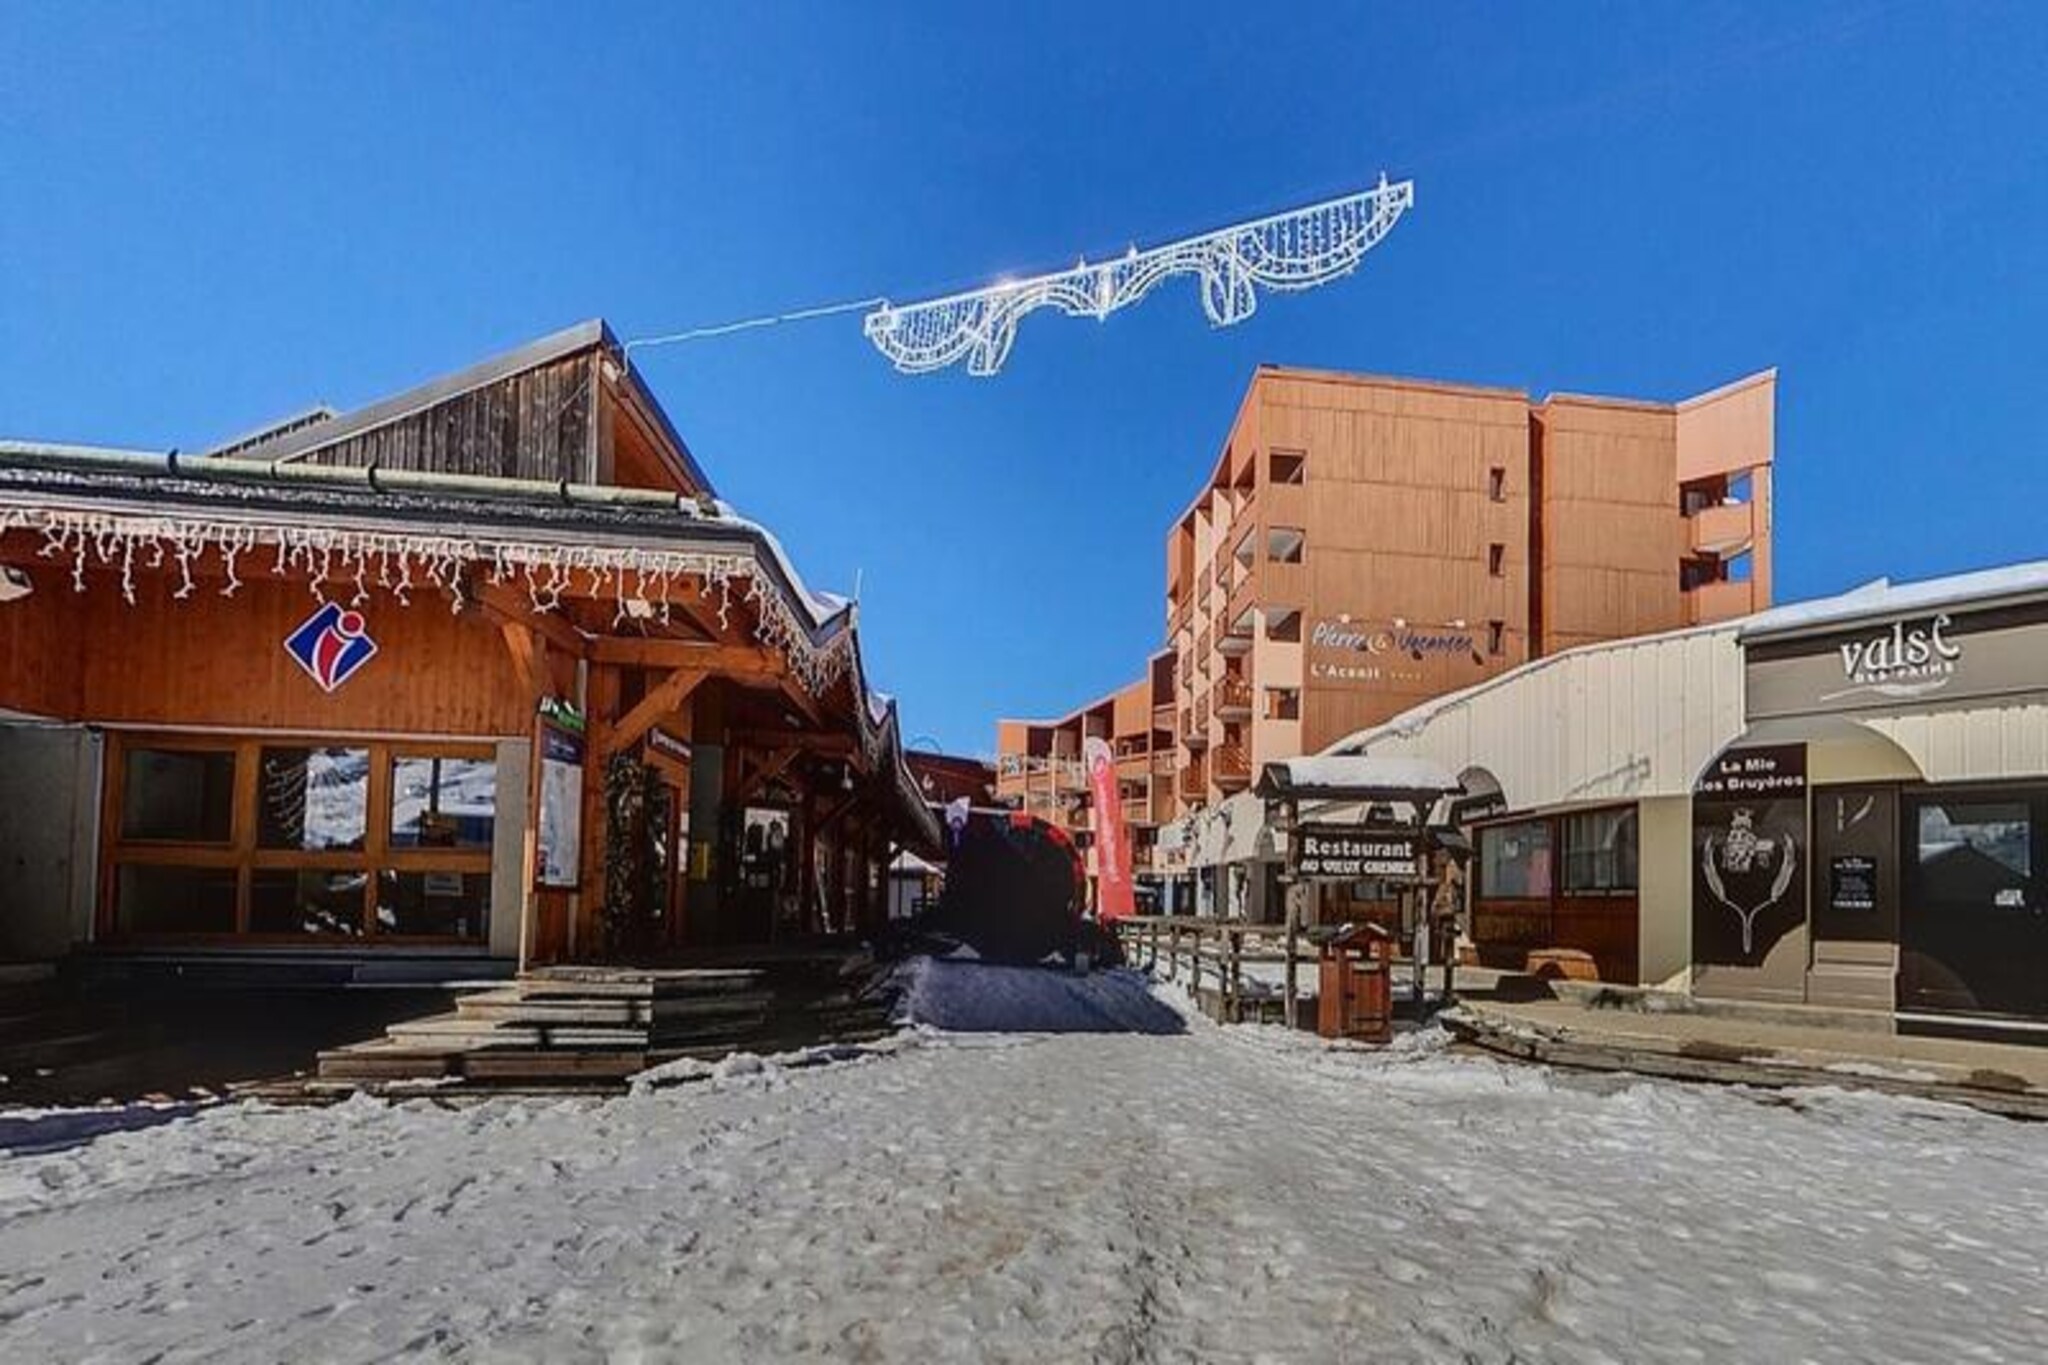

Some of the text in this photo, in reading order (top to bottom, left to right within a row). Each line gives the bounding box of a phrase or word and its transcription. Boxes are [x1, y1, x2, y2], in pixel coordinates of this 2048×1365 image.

[1720, 758, 1777, 774] La Mie
[1304, 838, 1413, 857] Restaurant
